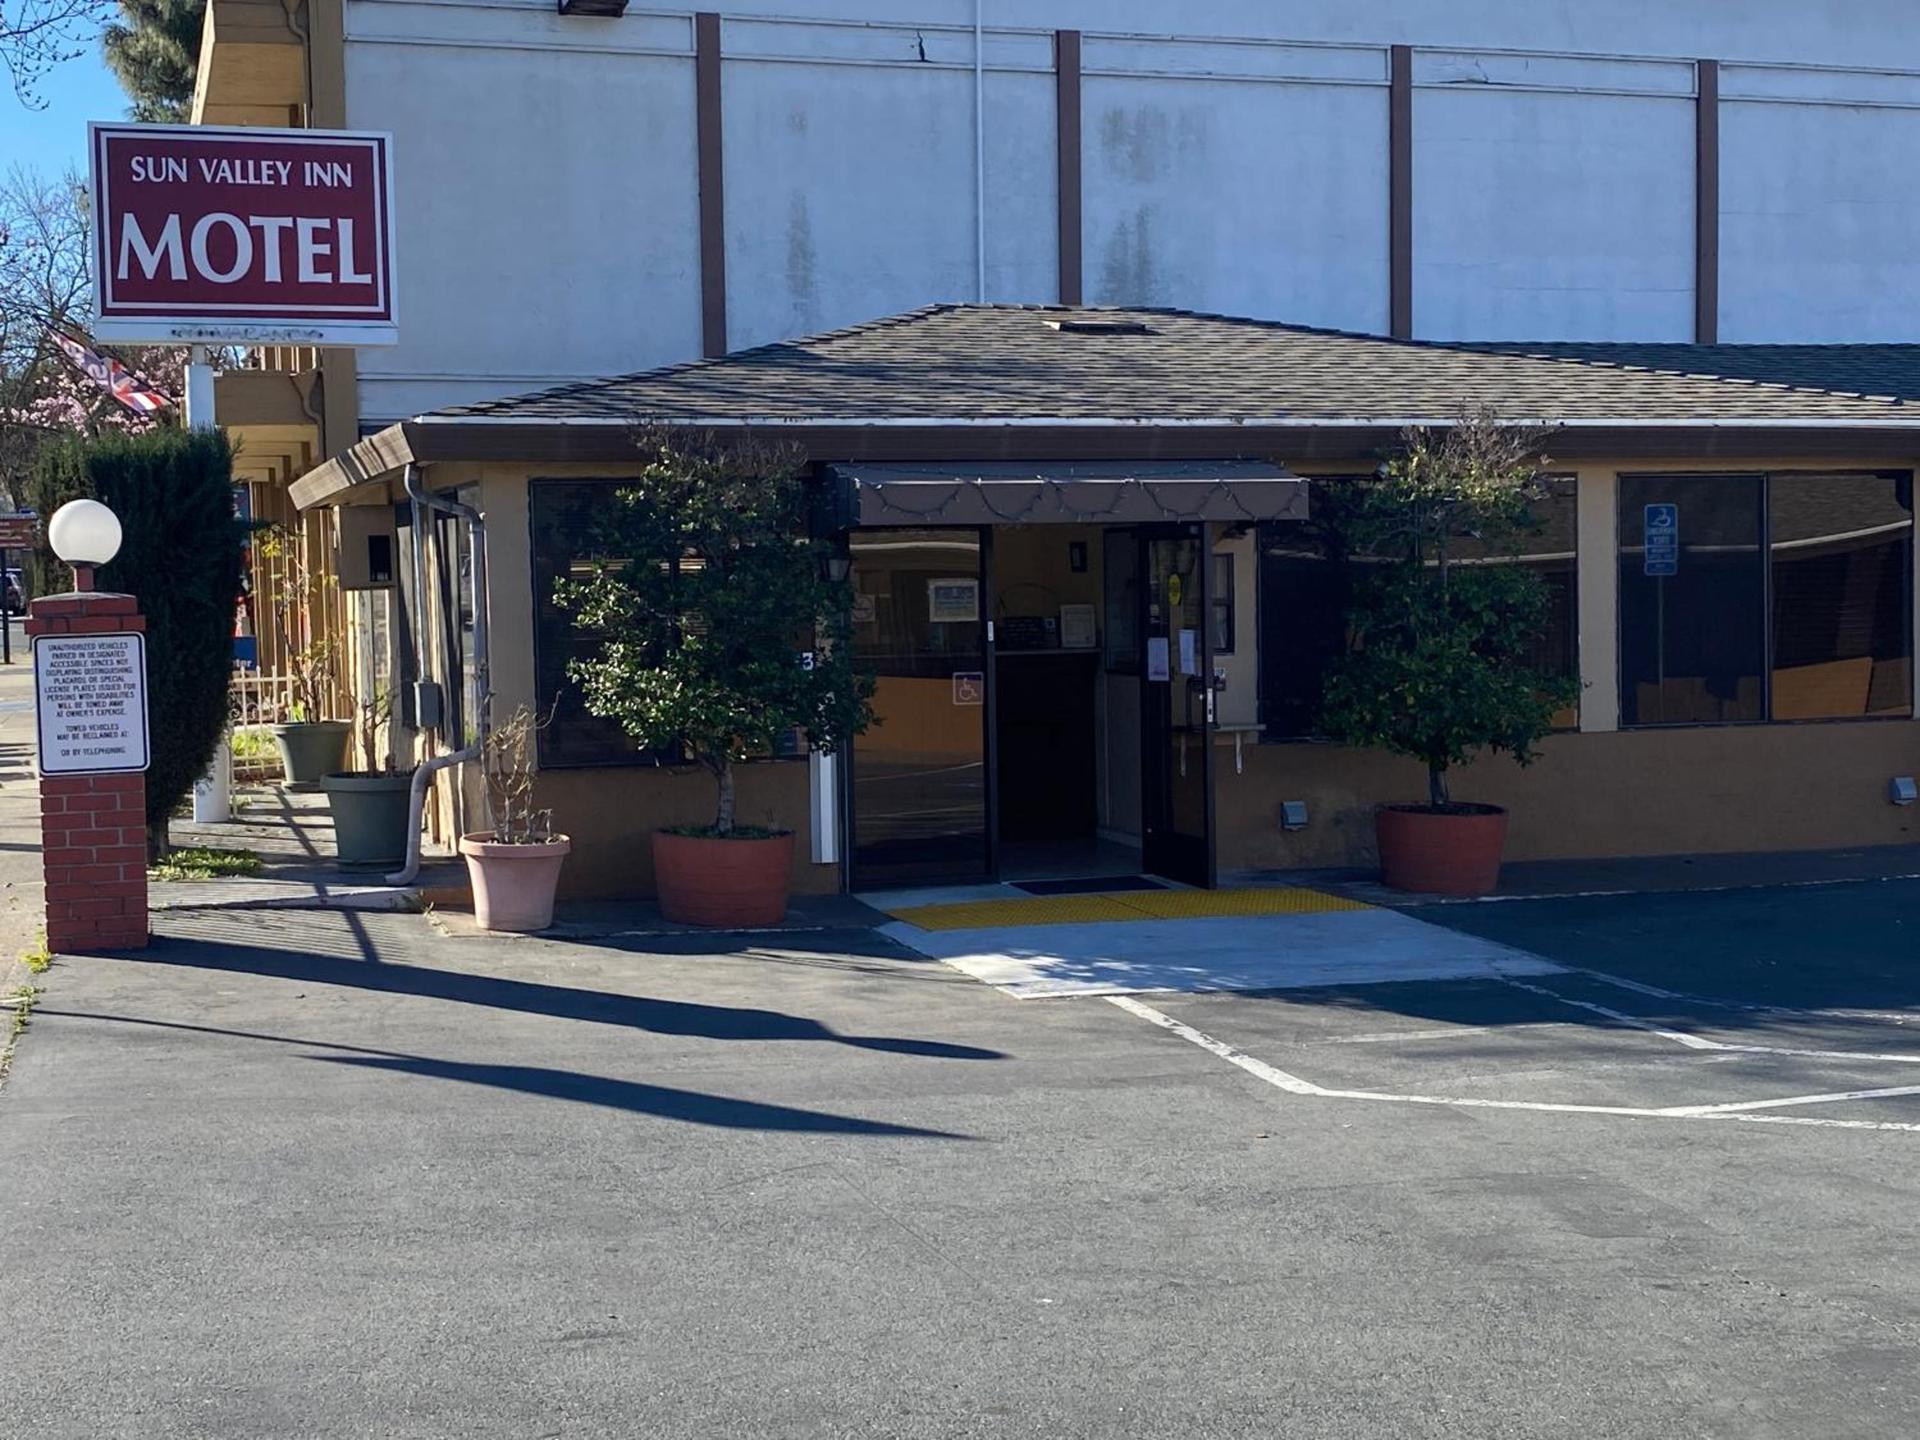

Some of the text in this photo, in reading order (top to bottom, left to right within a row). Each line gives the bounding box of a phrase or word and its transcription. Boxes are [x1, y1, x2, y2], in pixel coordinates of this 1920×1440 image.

[130, 155, 352, 188] SUN VALLEY INN
[117, 212, 372, 284] MOTEL
[48, 642, 128, 651] UNAUTHORIZED VEHICLES
[50, 660, 87, 668] ACCESSIBLE
[46, 667, 133, 676] DISPLAYING DISTINGUISHING
[95, 691, 134, 699] DISABILITIES
[66, 709, 94, 717] OWNER'S
[89, 723, 119, 731] VEHICLES
